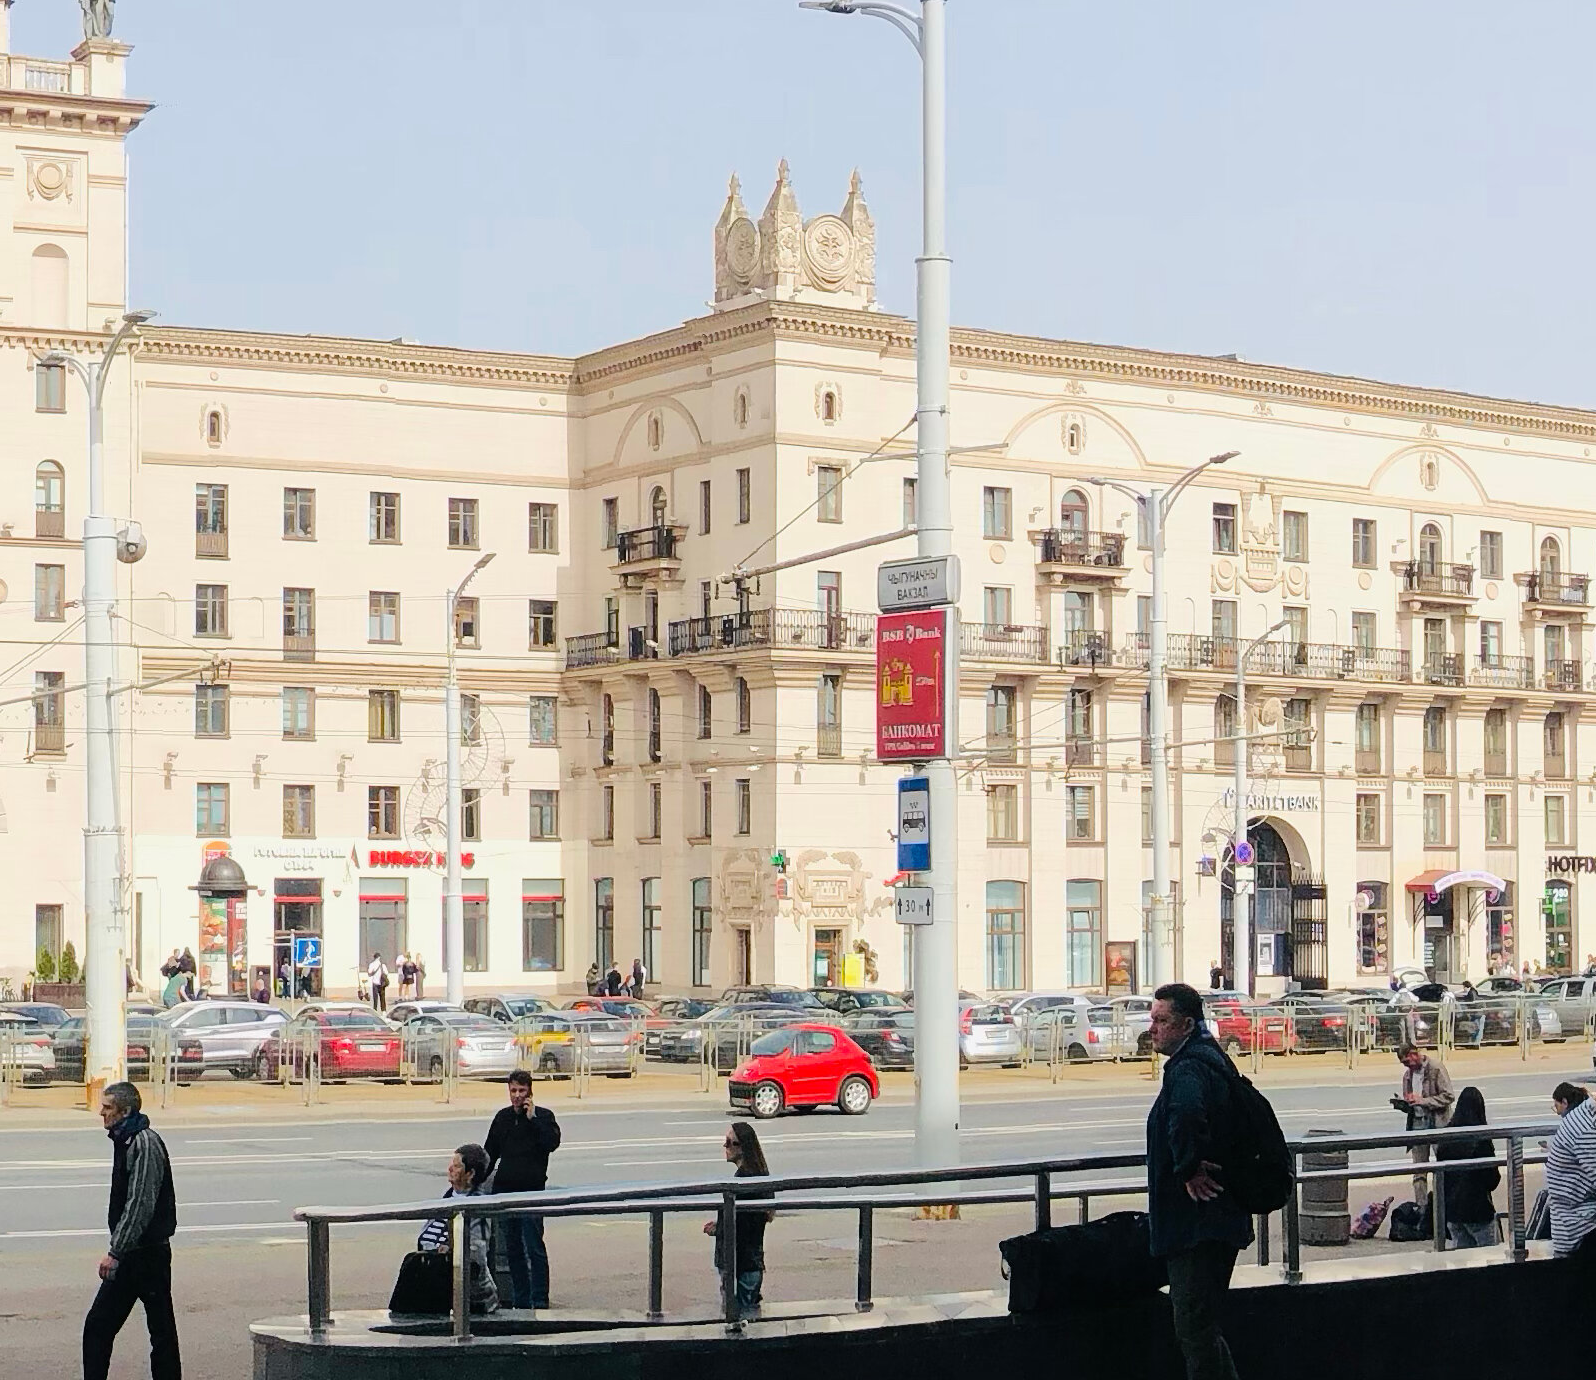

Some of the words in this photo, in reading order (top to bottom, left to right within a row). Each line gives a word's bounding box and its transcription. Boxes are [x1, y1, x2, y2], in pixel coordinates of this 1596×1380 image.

[888, 568, 938, 585] ЧЫГУНАЧНЫ
[897, 586, 929, 601] ВАКЗАЛ
[882, 628, 904, 643] BSB
[915, 627, 942, 639] Bank
[882, 724, 941, 738] БАНКОМАТ
[905, 900, 916, 913] 30
